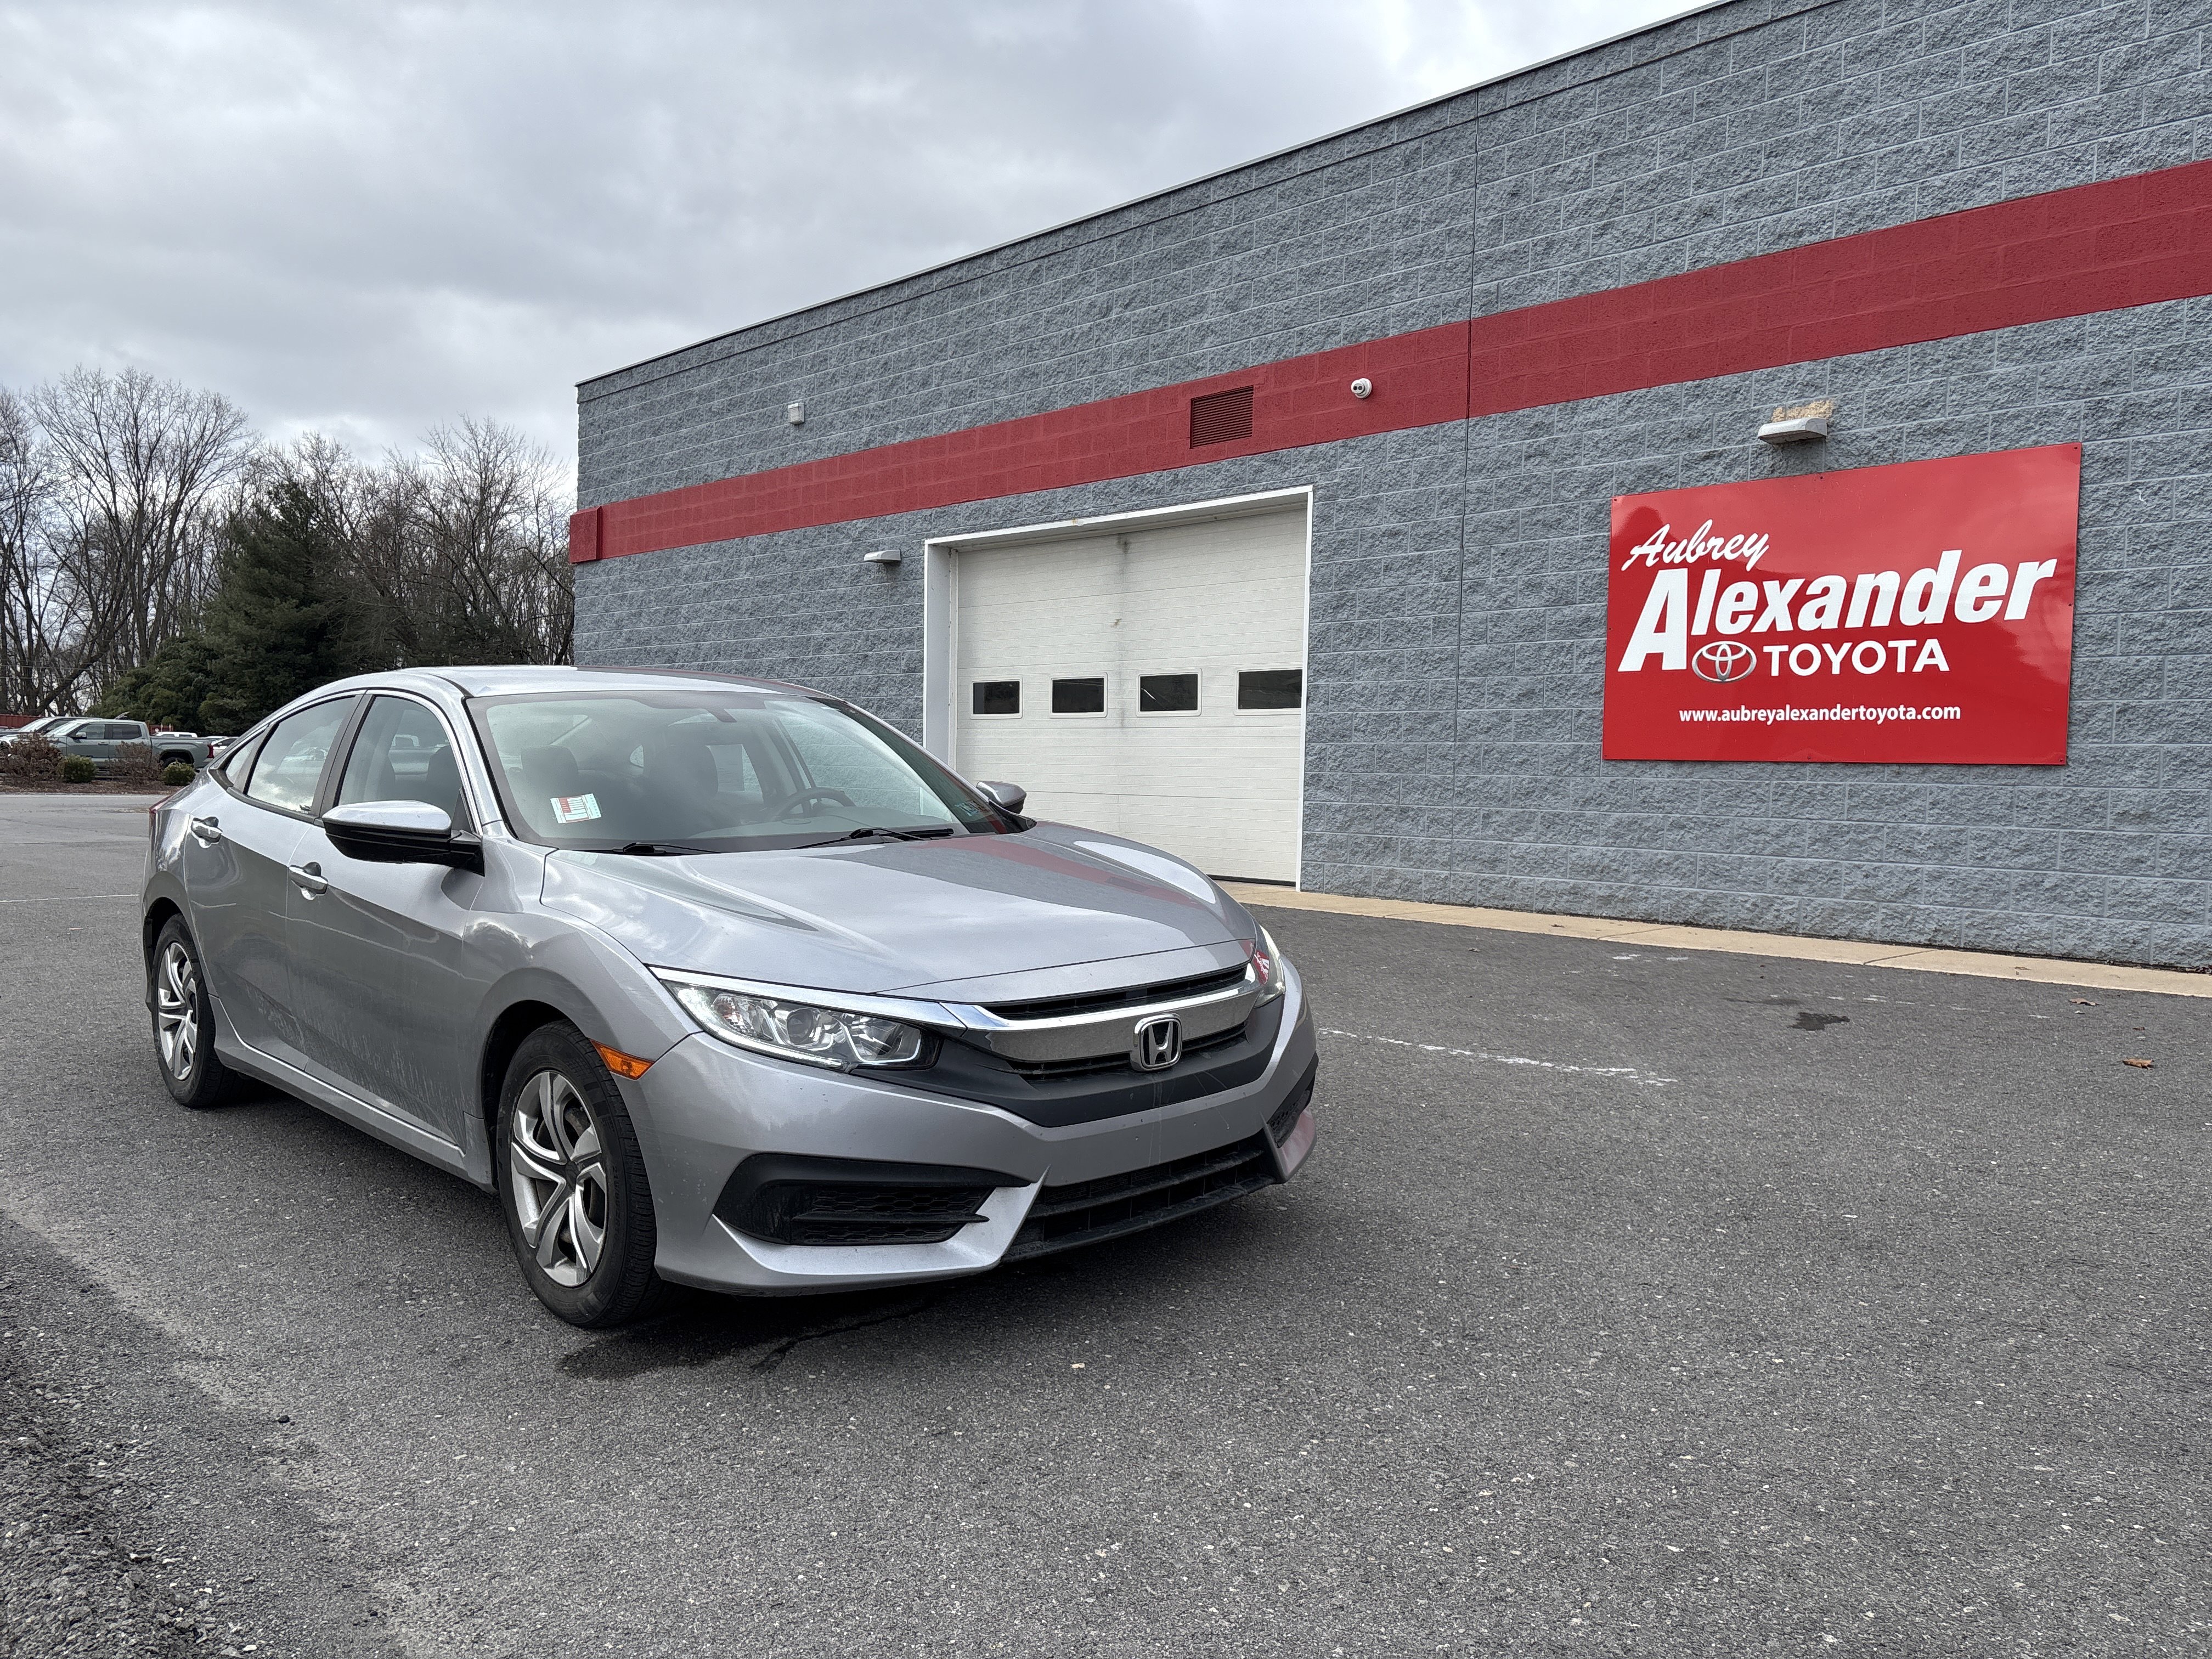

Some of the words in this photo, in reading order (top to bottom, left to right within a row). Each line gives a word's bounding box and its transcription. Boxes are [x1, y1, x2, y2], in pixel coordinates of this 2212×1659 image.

[1621, 519, 1769, 572] Aubrey
[1617, 549, 2058, 672] Alexander
[1763, 639, 1950, 676] TOYOTA
[1679, 703, 1961, 725] www.aubreyalexandertoyota.com
